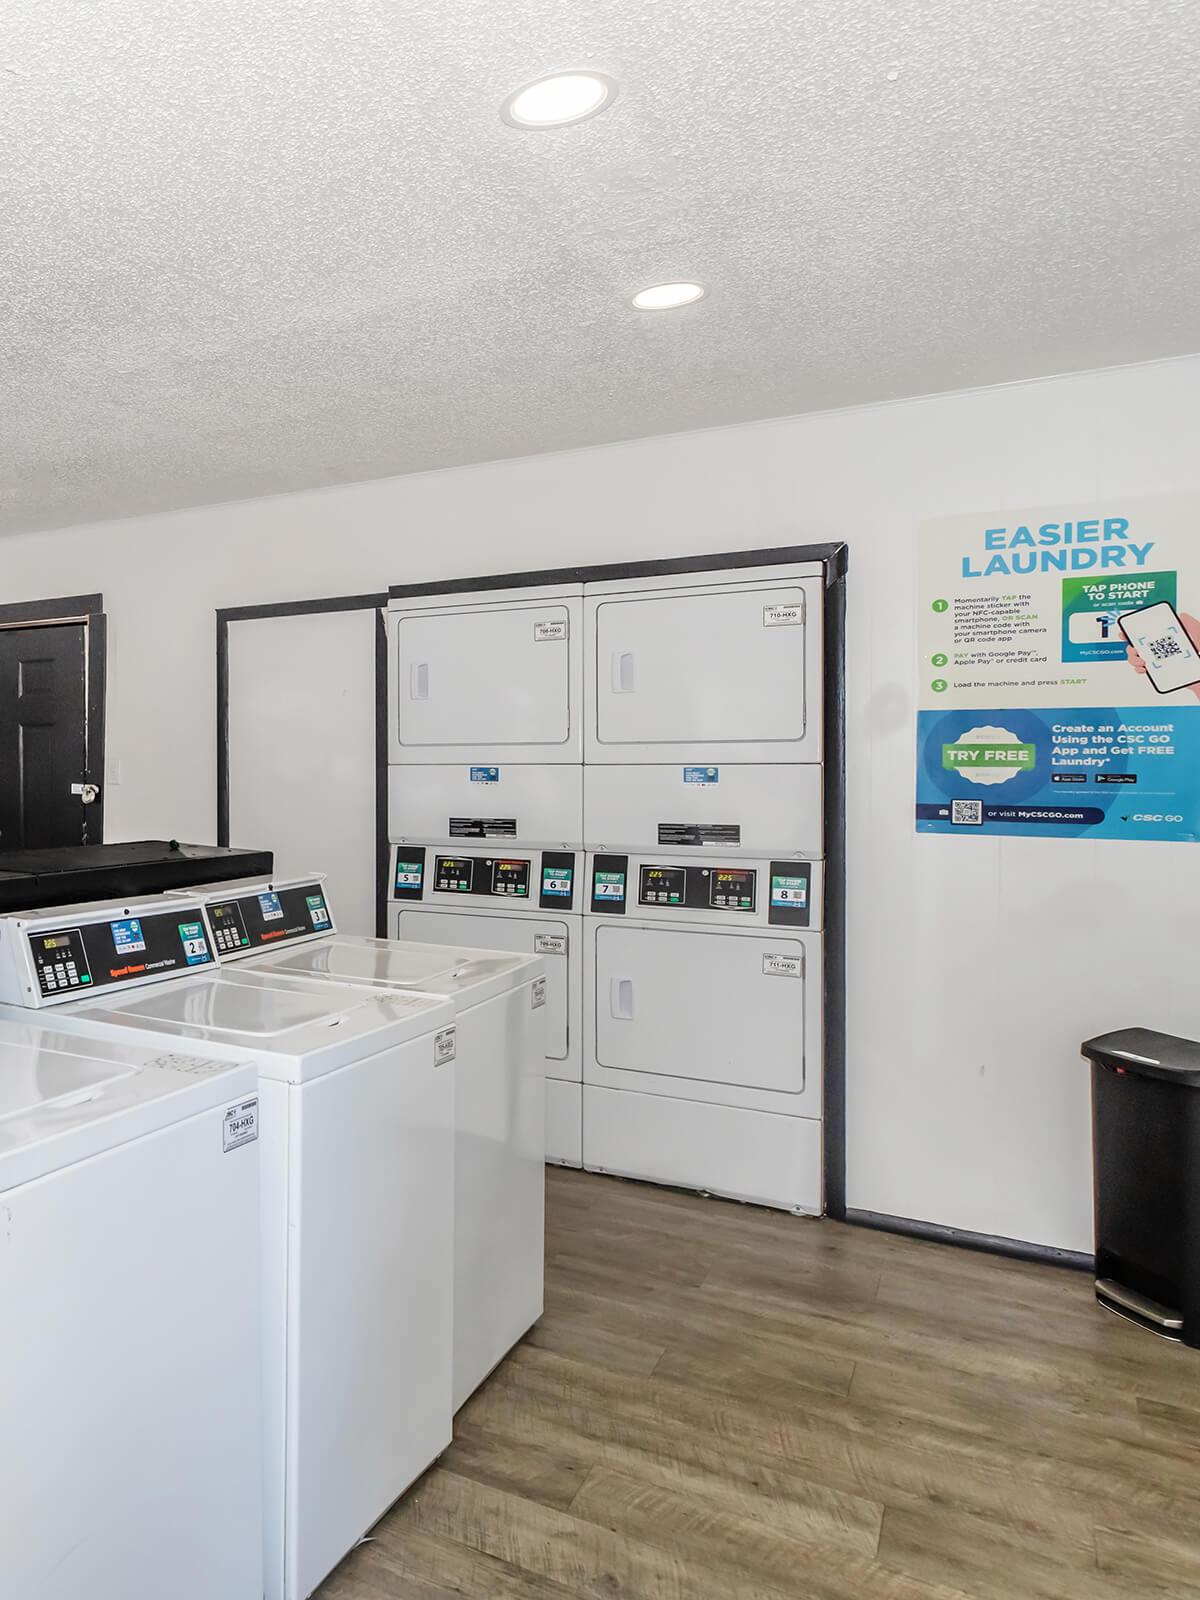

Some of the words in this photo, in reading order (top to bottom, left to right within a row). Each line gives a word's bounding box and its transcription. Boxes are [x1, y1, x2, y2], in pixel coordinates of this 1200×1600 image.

[984, 518, 1129, 551] EASIER
[962, 542, 1156, 578] LAUNDRY
[1082, 585, 1106, 593] TAP
[1109, 581, 1156, 591] PHONE
[1108, 590, 1149, 599] START
[954, 596, 1000, 604] Momentarily
[937, 602, 943, 610] 1
[972, 608, 1021, 616] NFC-capable
[954, 616, 1000, 624] smartphone,
[972, 628, 1017, 636] smartphone
[988, 650, 1016, 658] Google
[935, 656, 943, 665] 2
[935, 681, 943, 690] 3
[1052, 724, 1095, 733] Create
[1118, 723, 1174, 732] Account
[1052, 735, 1088, 745] Using
[1091, 735, 1113, 743] the
[1117, 735, 1144, 743] CSC
[1149, 735, 1170, 743] GO
[947, 750, 980, 761] TRY
[984, 750, 1030, 761] FREE
[1052, 746, 1079, 756] App
[1082, 746, 1107, 754] and
[1110, 746, 1134, 754] Get
[1138, 746, 1175, 754] FREE
[1018, 811, 1084, 820] MyCSCGO.com
[1133, 814, 1163, 822] CSC
[1164, 814, 1184, 823] GO
[403, 874, 409, 882] 5
[550, 881, 557, 889] 6
[602, 885, 609, 894] 7
[780, 890, 788, 899] 8
[314, 911, 320, 922] 3
[189, 942, 196, 954] 2
[229, 1115, 254, 1132] 704-HXG
